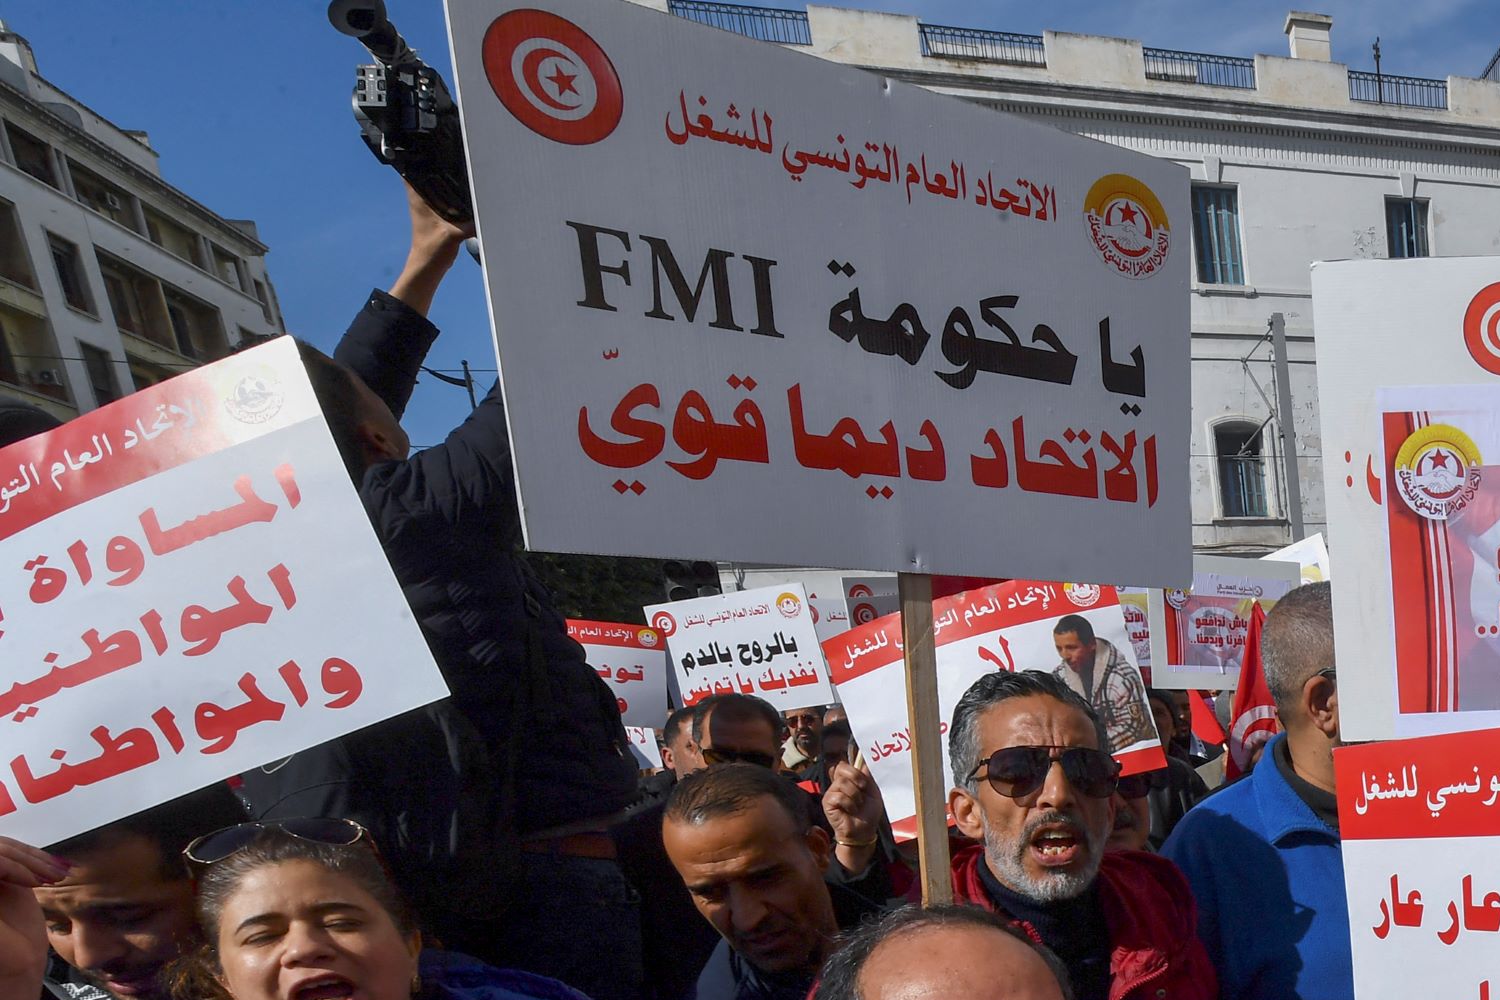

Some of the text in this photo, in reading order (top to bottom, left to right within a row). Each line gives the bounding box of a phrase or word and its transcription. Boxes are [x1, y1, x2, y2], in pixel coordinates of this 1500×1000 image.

[665, 89, 1058, 223] الاتحاد العام التونسي للشغل
[566, 219, 785, 340] FMI
[827, 259, 1147, 418] يا حكومة
[51, 432, 113, 492] العام
[787, 384, 948, 502] ديما
[970, 415, 1161, 510] الاتحاد
[0, 461, 41, 514] التو
[23, 462, 302, 605] المساواة
[964, 598, 1002, 629] العام
[1007, 583, 1057, 612] الإتحاد
[0, 562, 299, 723] المواطني
[680, 631, 799, 677] بالروح بالدم
[842, 629, 889, 669] للشغل
[597, 663, 645, 685] تون
[758, 659, 820, 695] نفديك
[870, 727, 912, 763] لاتحاد
[1354, 763, 1418, 816] للشغل
[1371, 873, 1424, 940] عار
